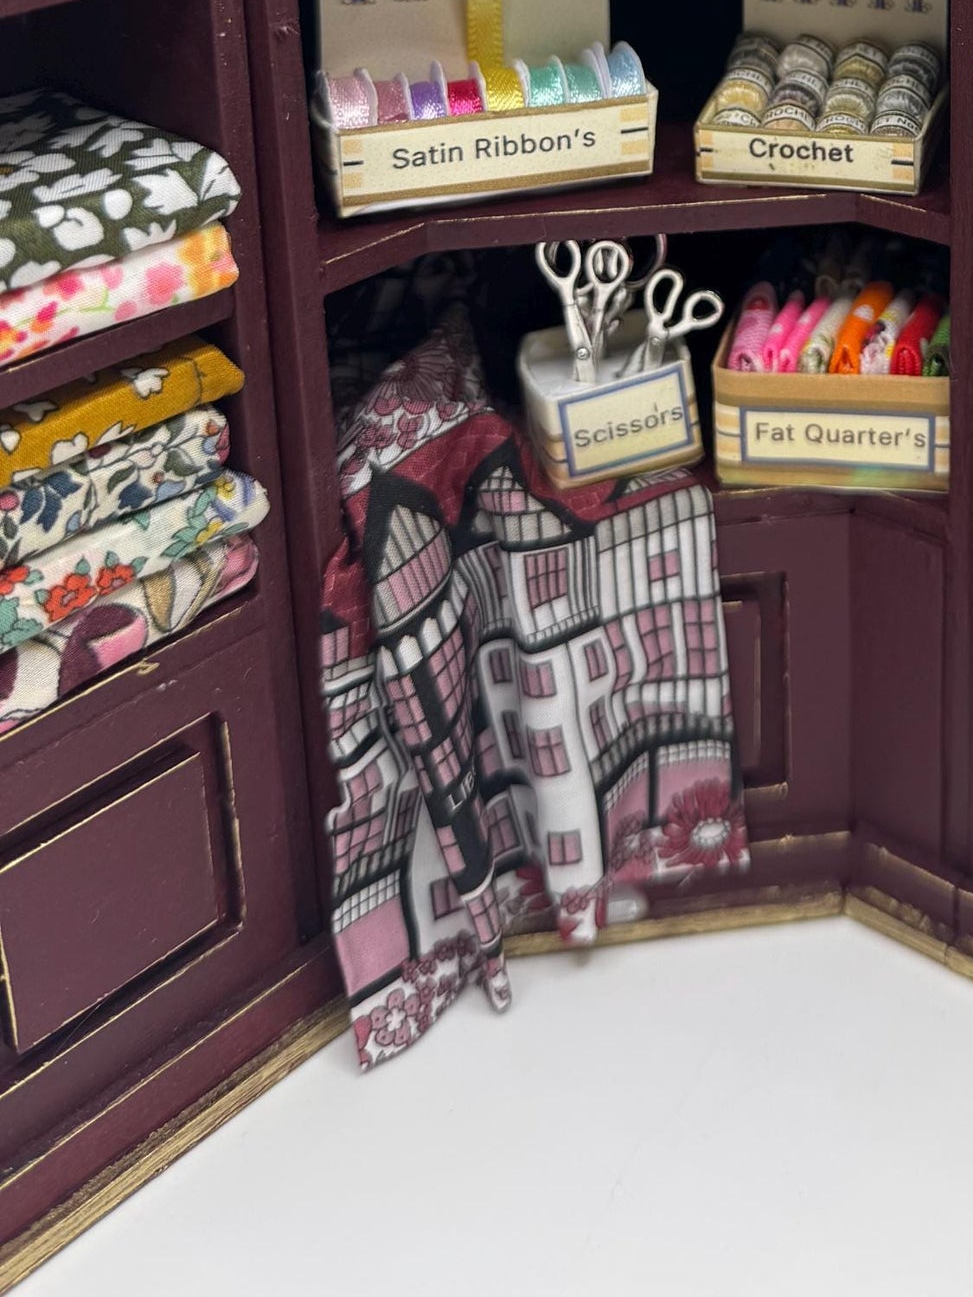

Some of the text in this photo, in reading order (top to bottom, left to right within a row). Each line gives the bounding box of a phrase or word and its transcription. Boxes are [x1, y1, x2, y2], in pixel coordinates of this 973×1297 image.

[392, 128, 597, 170] Satin Ribbon's
[749, 138, 854, 163] Crochet
[755, 422, 926, 449] Fat Quarter's
